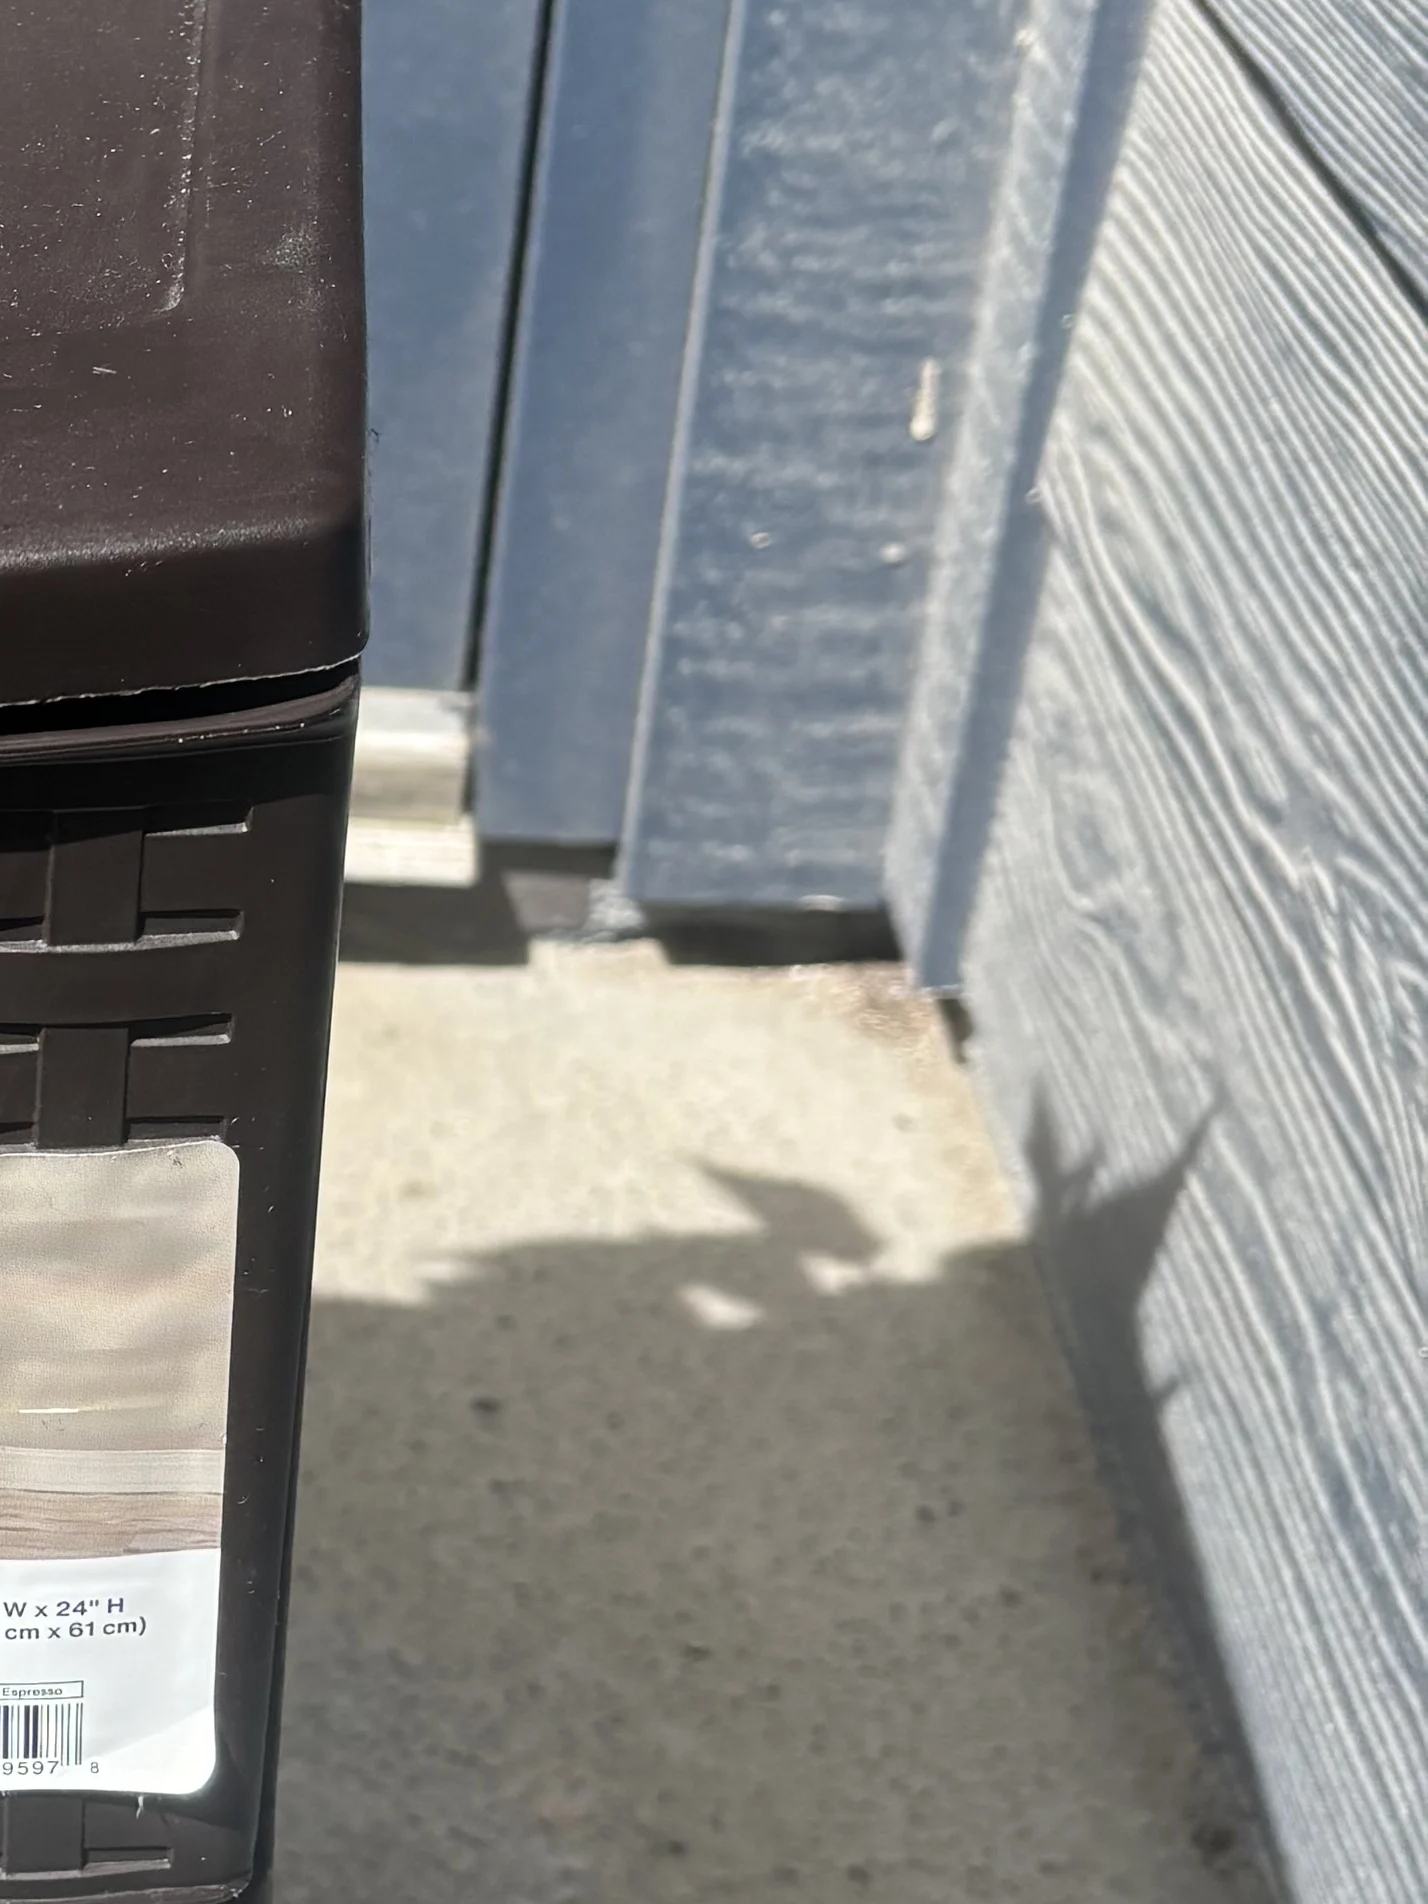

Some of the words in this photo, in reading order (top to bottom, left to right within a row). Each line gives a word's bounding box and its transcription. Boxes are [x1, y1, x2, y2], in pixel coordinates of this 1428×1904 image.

[3, 1602, 28, 1618] W
[34, 1604, 48, 1617] x
[56, 1599, 100, 1617] 24"
[107, 1597, 125, 1614] H
[4, 1627, 40, 1641] cm
[47, 1626, 61, 1639] x
[68, 1621, 95, 1638] 61
[102, 1616, 147, 1637] cm)
[2, 1687, 63, 1700] Espresso
[90, 1761, 100, 1774] 8
